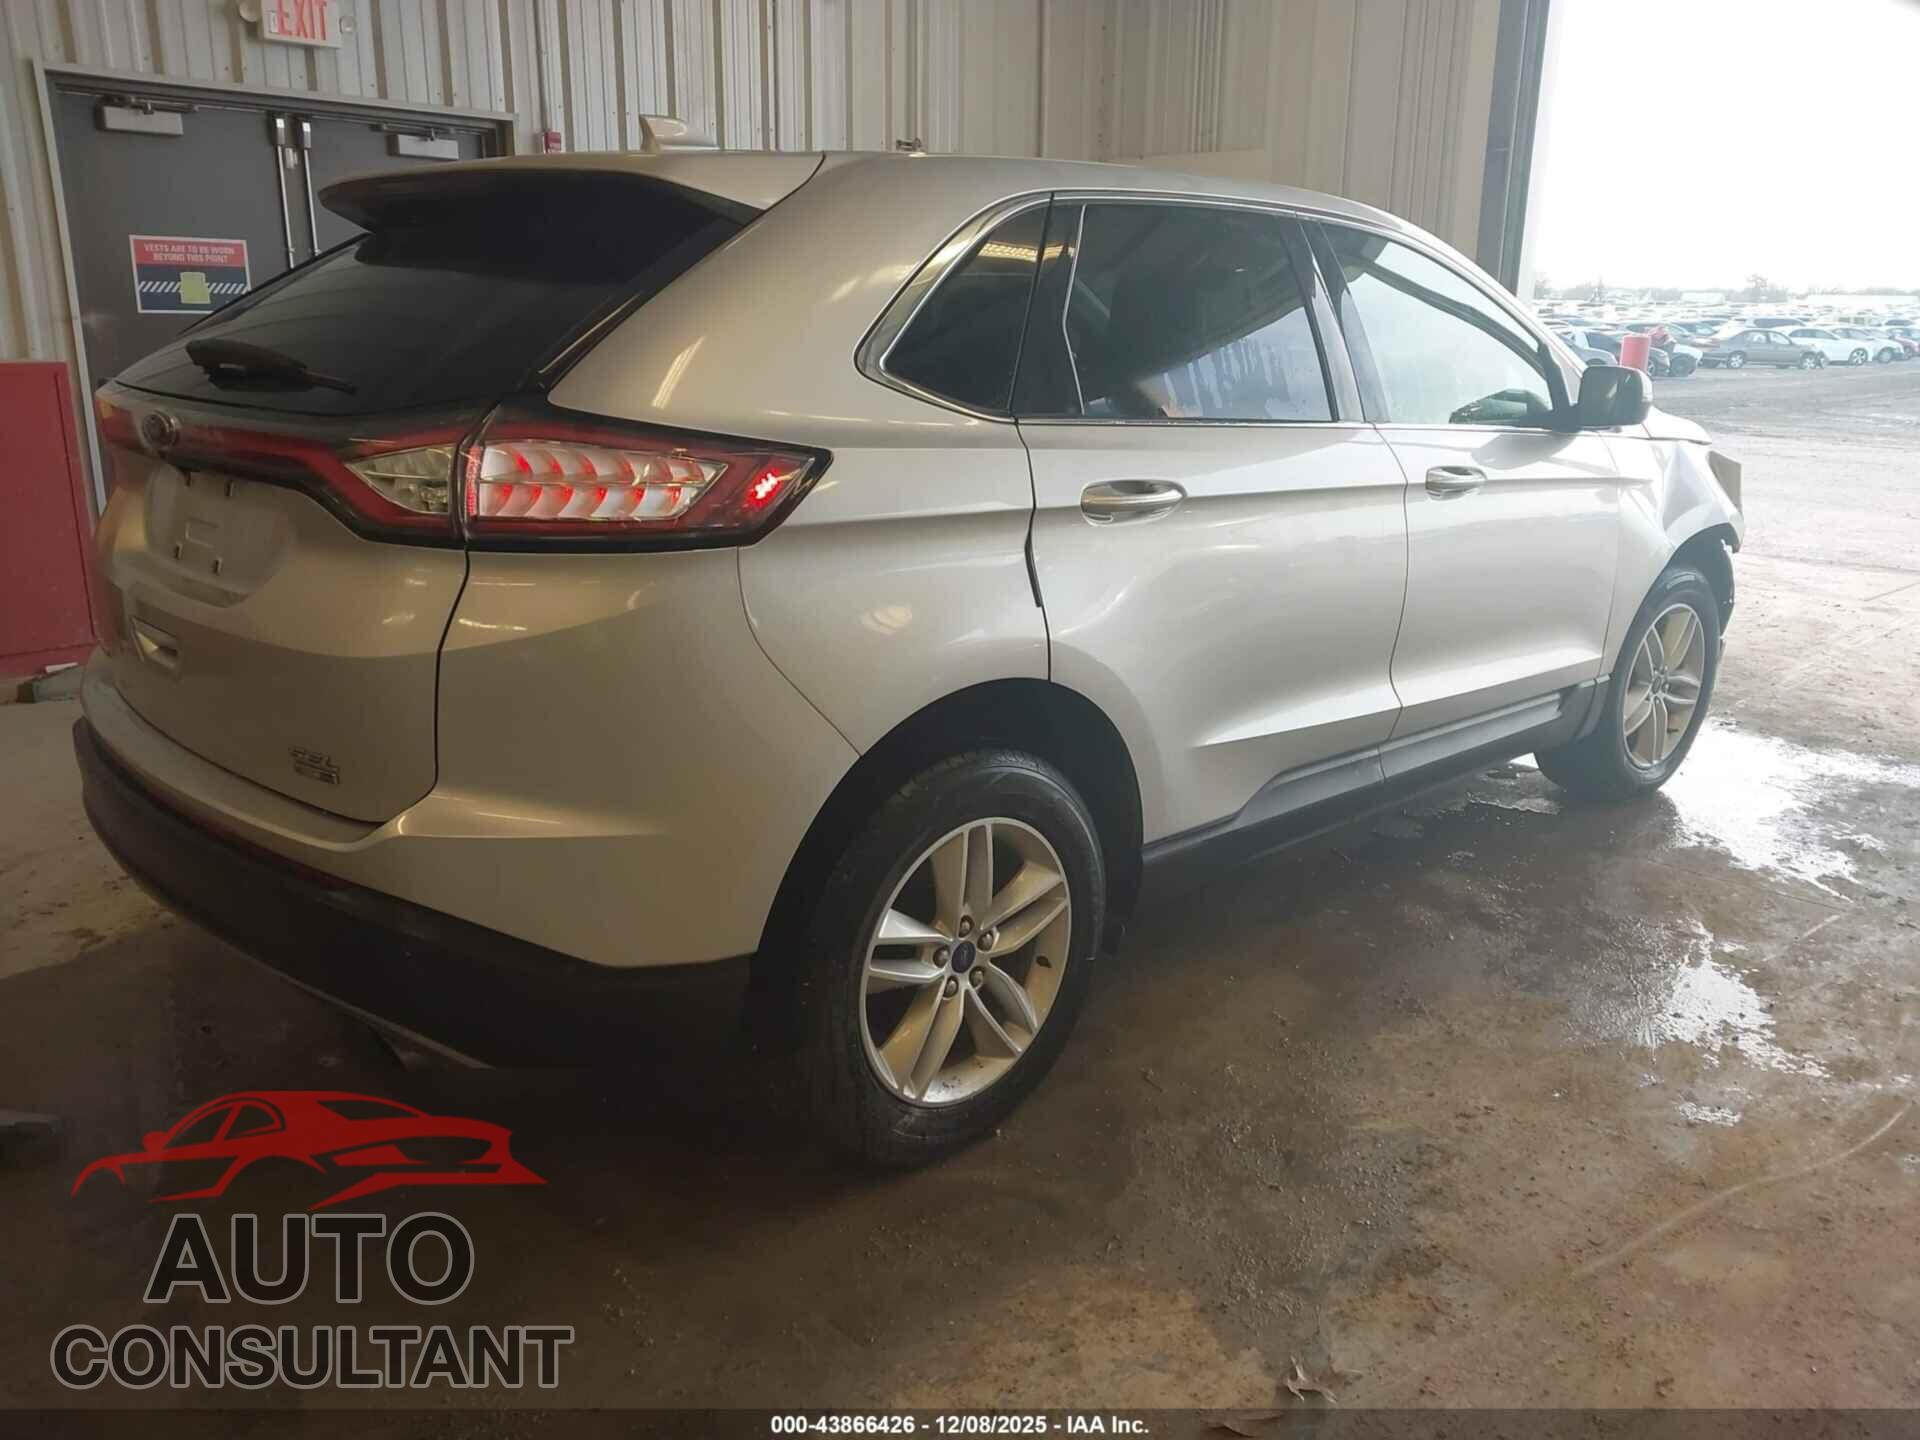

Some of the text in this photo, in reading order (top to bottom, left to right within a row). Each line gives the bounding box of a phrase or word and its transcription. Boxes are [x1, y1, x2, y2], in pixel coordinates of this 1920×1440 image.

[277, 0, 327, 40] EXIT
[144, 243, 169, 252] VESTS
[170, 244, 186, 253] ARE
[187, 245, 198, 254] TO
[199, 245, 209, 254] BE
[153, 252, 228, 264] BEYOND THIS POINT
